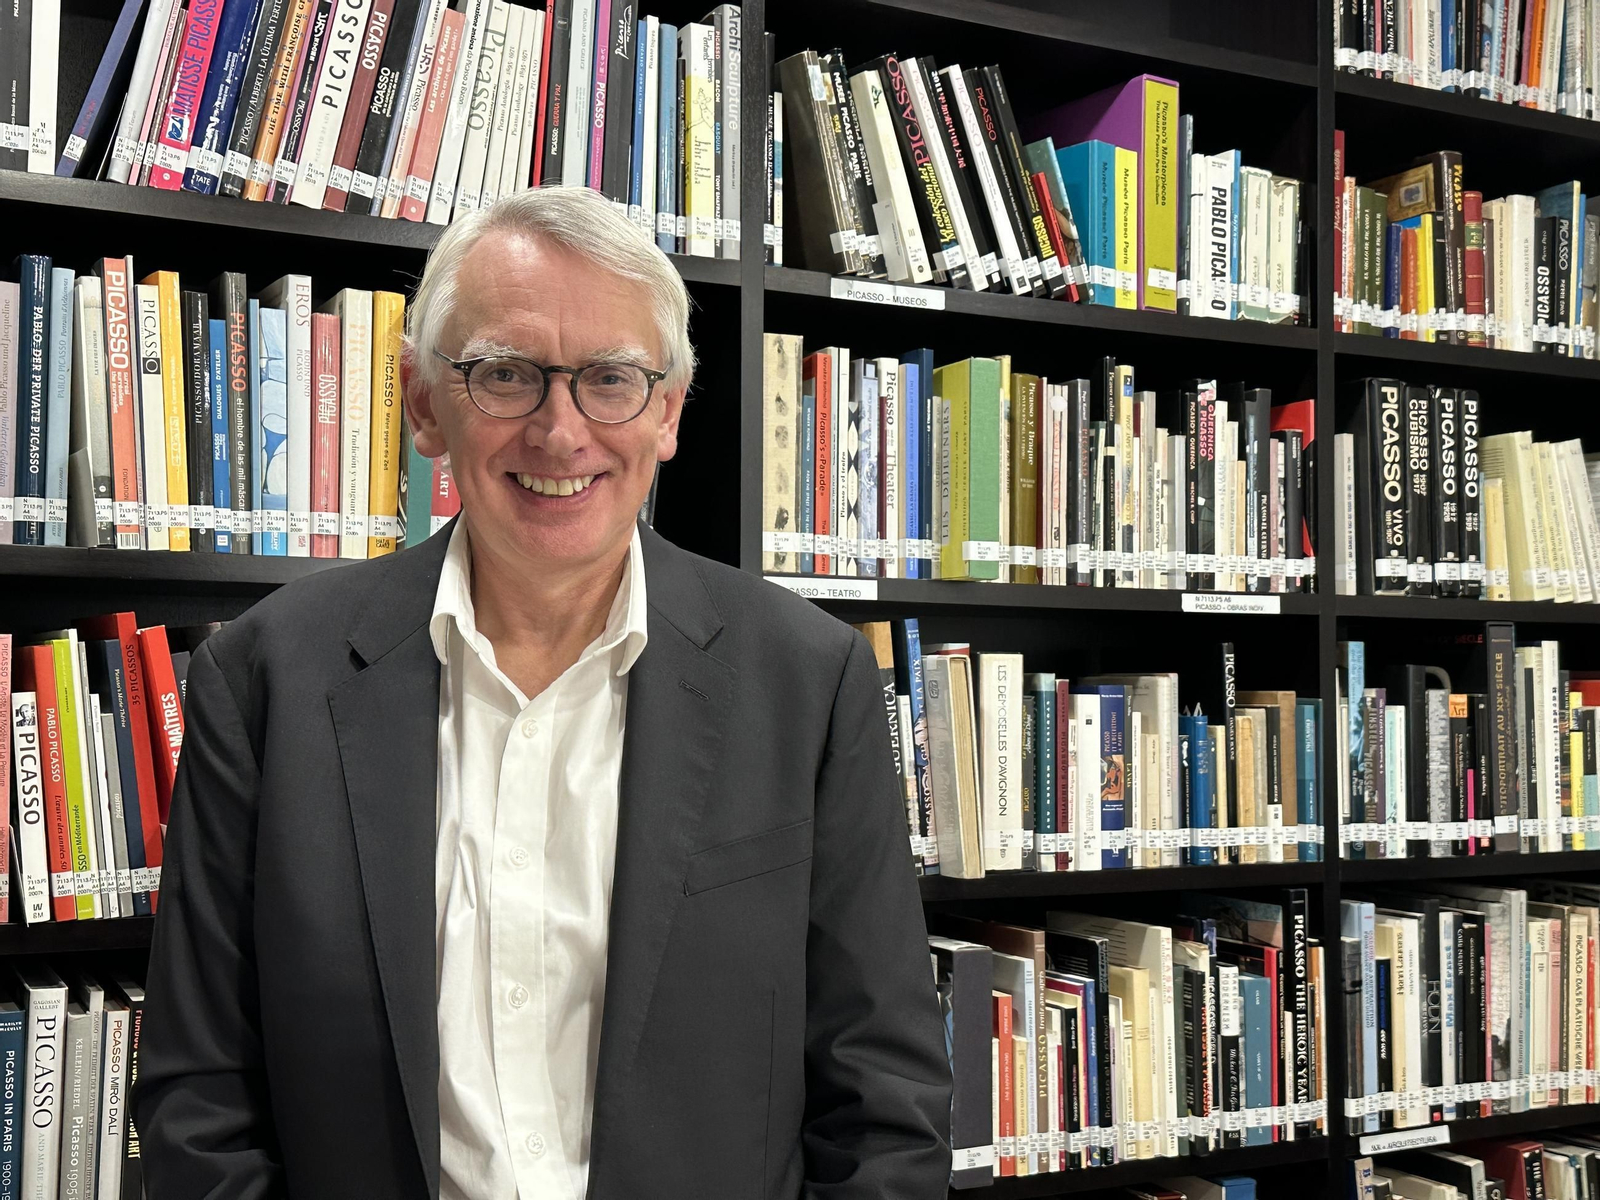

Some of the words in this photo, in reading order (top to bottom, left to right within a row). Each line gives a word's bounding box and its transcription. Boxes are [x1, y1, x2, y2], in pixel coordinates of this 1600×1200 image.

[261, 26, 276, 58] ÚLTIMA
[361, 10, 388, 70] PICASSO
[439, 25, 452, 55] Picasso
[259, 59, 268, 70] LA
[268, 116, 277, 135] THE
[273, 91, 284, 115] TIME
[279, 65, 290, 91] WITH
[286, 13, 303, 61] FRANÇOISE
[438, 55, 445, 65] de
[467, 27, 507, 132] Picasso
[728, 6, 741, 131] ArchiSculpture
[176, 51, 204, 115] MATISSE
[371, 67, 392, 115] PICASSO
[411, 78, 426, 111] Picasso
[431, 67, 443, 101] archives
[554, 83, 563, 95] PAZ
[714, 79, 722, 103] BACON
[931, 71, 943, 93] 2011
[427, 101, 437, 113] Les
[497, 110, 508, 132] Picasso
[552, 102, 561, 127] GUERRA
[594, 81, 607, 129] PICASSO
[886, 55, 932, 167] PICASSO
[955, 77, 982, 148] PICASSO
[975, 87, 997, 142] PICASSO
[1161, 101, 1169, 145] Picasso's
[240, 113, 255, 147] PICASSO
[511, 114, 520, 137] Picasso
[840, 106, 856, 149] PICASSO
[850, 151, 862, 180] PARIS
[195, 173, 212, 187] TATE
[918, 167, 930, 182] del
[924, 162, 947, 208] Nacional
[926, 184, 945, 229] colección
[941, 208, 957, 241] Museo
[1211, 186, 1227, 239] PABLO
[1101, 235, 1109, 260] Paris
[1558, 218, 1571, 271] PICASSO
[1211, 241, 1227, 311] PICAO
[296, 284, 310, 327] EROS
[846, 289, 885, 303] PICASSO
[892, 295, 928, 307] MUSEOS
[1, 299, 12, 341] Jacqueline
[106, 270, 130, 370] PICASSO
[143, 299, 160, 374] PICASSO
[31, 348, 42, 372] DER
[58, 339, 67, 373] PICASSO
[231, 311, 247, 393] PICASSO
[0, 360, 9, 390] Picasso
[57, 373, 65, 399] PABLO
[384, 353, 394, 407] PICASSO
[0, 390, 8, 413] Pablo
[30, 374, 42, 422] PRIVATE
[236, 397, 244, 407] el
[318, 373, 337, 424] PICASSO
[886, 371, 896, 426] Picasso
[1028, 382, 1036, 418] Picasso
[236, 406, 244, 438] hombre
[819, 412, 828, 451] Picasso's
[1027, 419, 1035, 428] y
[1207, 404, 1216, 462] GUERNICA
[1409, 398, 1419, 471] CUBISMO
[1418, 399, 1429, 471] PICASSO
[29, 425, 41, 474] PICASSO
[237, 440, 245, 451] de
[237, 453, 245, 465] las
[350, 428, 361, 469] Tradición
[1027, 430, 1036, 466] Braque
[1440, 398, 1457, 495] PICASSO
[1464, 399, 1479, 498] PICASSO
[439, 471, 449, 499] ART
[885, 450, 896, 510] Theater
[1381, 386, 1402, 502] PICASSO
[1392, 508, 1405, 546] VIVO
[789, 587, 819, 597] CASSO
[827, 588, 862, 598] TEATRO
[1195, 603, 1222, 611] PICASSO
[0, 643, 9, 678] PICASSO
[126, 643, 139, 694] PICASSOS
[913, 658, 922, 683] PAIX
[998, 664, 1007, 681] LES
[916, 686, 923, 701] LA
[1224, 653, 1236, 708] PICASSO
[46, 707, 58, 739] PABLO
[161, 692, 184, 748] MAÎTRES
[998, 682, 1008, 752] DEMOISELLES
[1497, 715, 1504, 731] AU
[19, 732, 41, 826] PICASSO
[48, 741, 62, 783] PICASSO
[998, 754, 1008, 817] D'AVIGNON
[72, 803, 83, 848] Méditerranée
[58, 835, 67, 860] années
[60, 860, 68, 870] 50
[77, 845, 83, 854] en
[1294, 914, 1305, 978] PICASSO
[1222, 972, 1230, 1032] MODERNISM
[1295, 980, 1305, 1011] THE
[1038, 1008, 1046, 1030] trente
[110, 1019, 123, 1074] PICASSO
[1296, 1013, 1306, 1066] HEROIC
[5, 1050, 15, 1100] PICASSO
[32, 1015, 57, 1129] PICASSO
[72, 1037, 84, 1110] KELLEIN/RIEDEL
[1038, 1034, 1049, 1098] PICASSO
[1297, 1067, 1308, 1104] YEAR
[3, 1102, 14, 1115] IN
[109, 1076, 121, 1105] MIRÓ
[1104, 1079, 1112, 1118] Picasso
[3, 1118, 14, 1152] PARIS
[70, 1115, 84, 1167] Picasso
[107, 1107, 119, 1136] DALÍ
[37, 1133, 45, 1153] AND
[128, 1139, 141, 1159] ART
[66, 1168, 79, 1196] 1905
